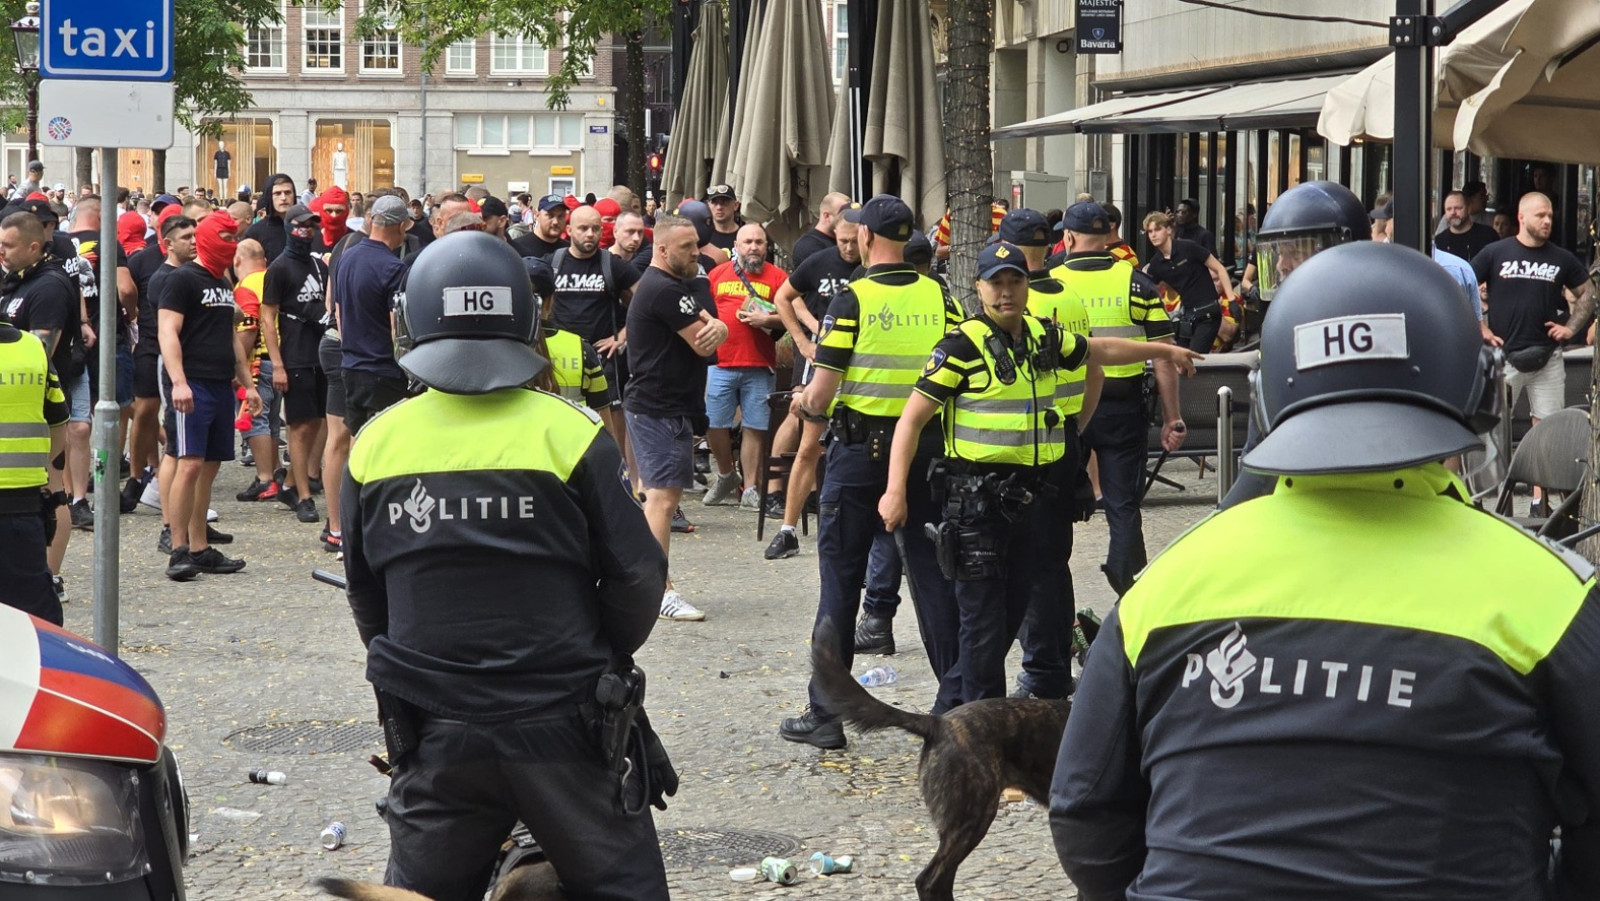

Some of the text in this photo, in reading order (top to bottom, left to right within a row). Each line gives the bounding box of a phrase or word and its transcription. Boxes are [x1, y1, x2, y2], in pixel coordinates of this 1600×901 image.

[58, 18, 155, 58] taxi
[1080, 39, 1116, 49] Bavaria
[1499, 260, 1519, 276] ZA
[464, 291, 494, 312] HG
[1323, 322, 1373, 357] HG
[388, 493, 535, 533] POLITIE
[1181, 650, 1417, 709] POLITIE
